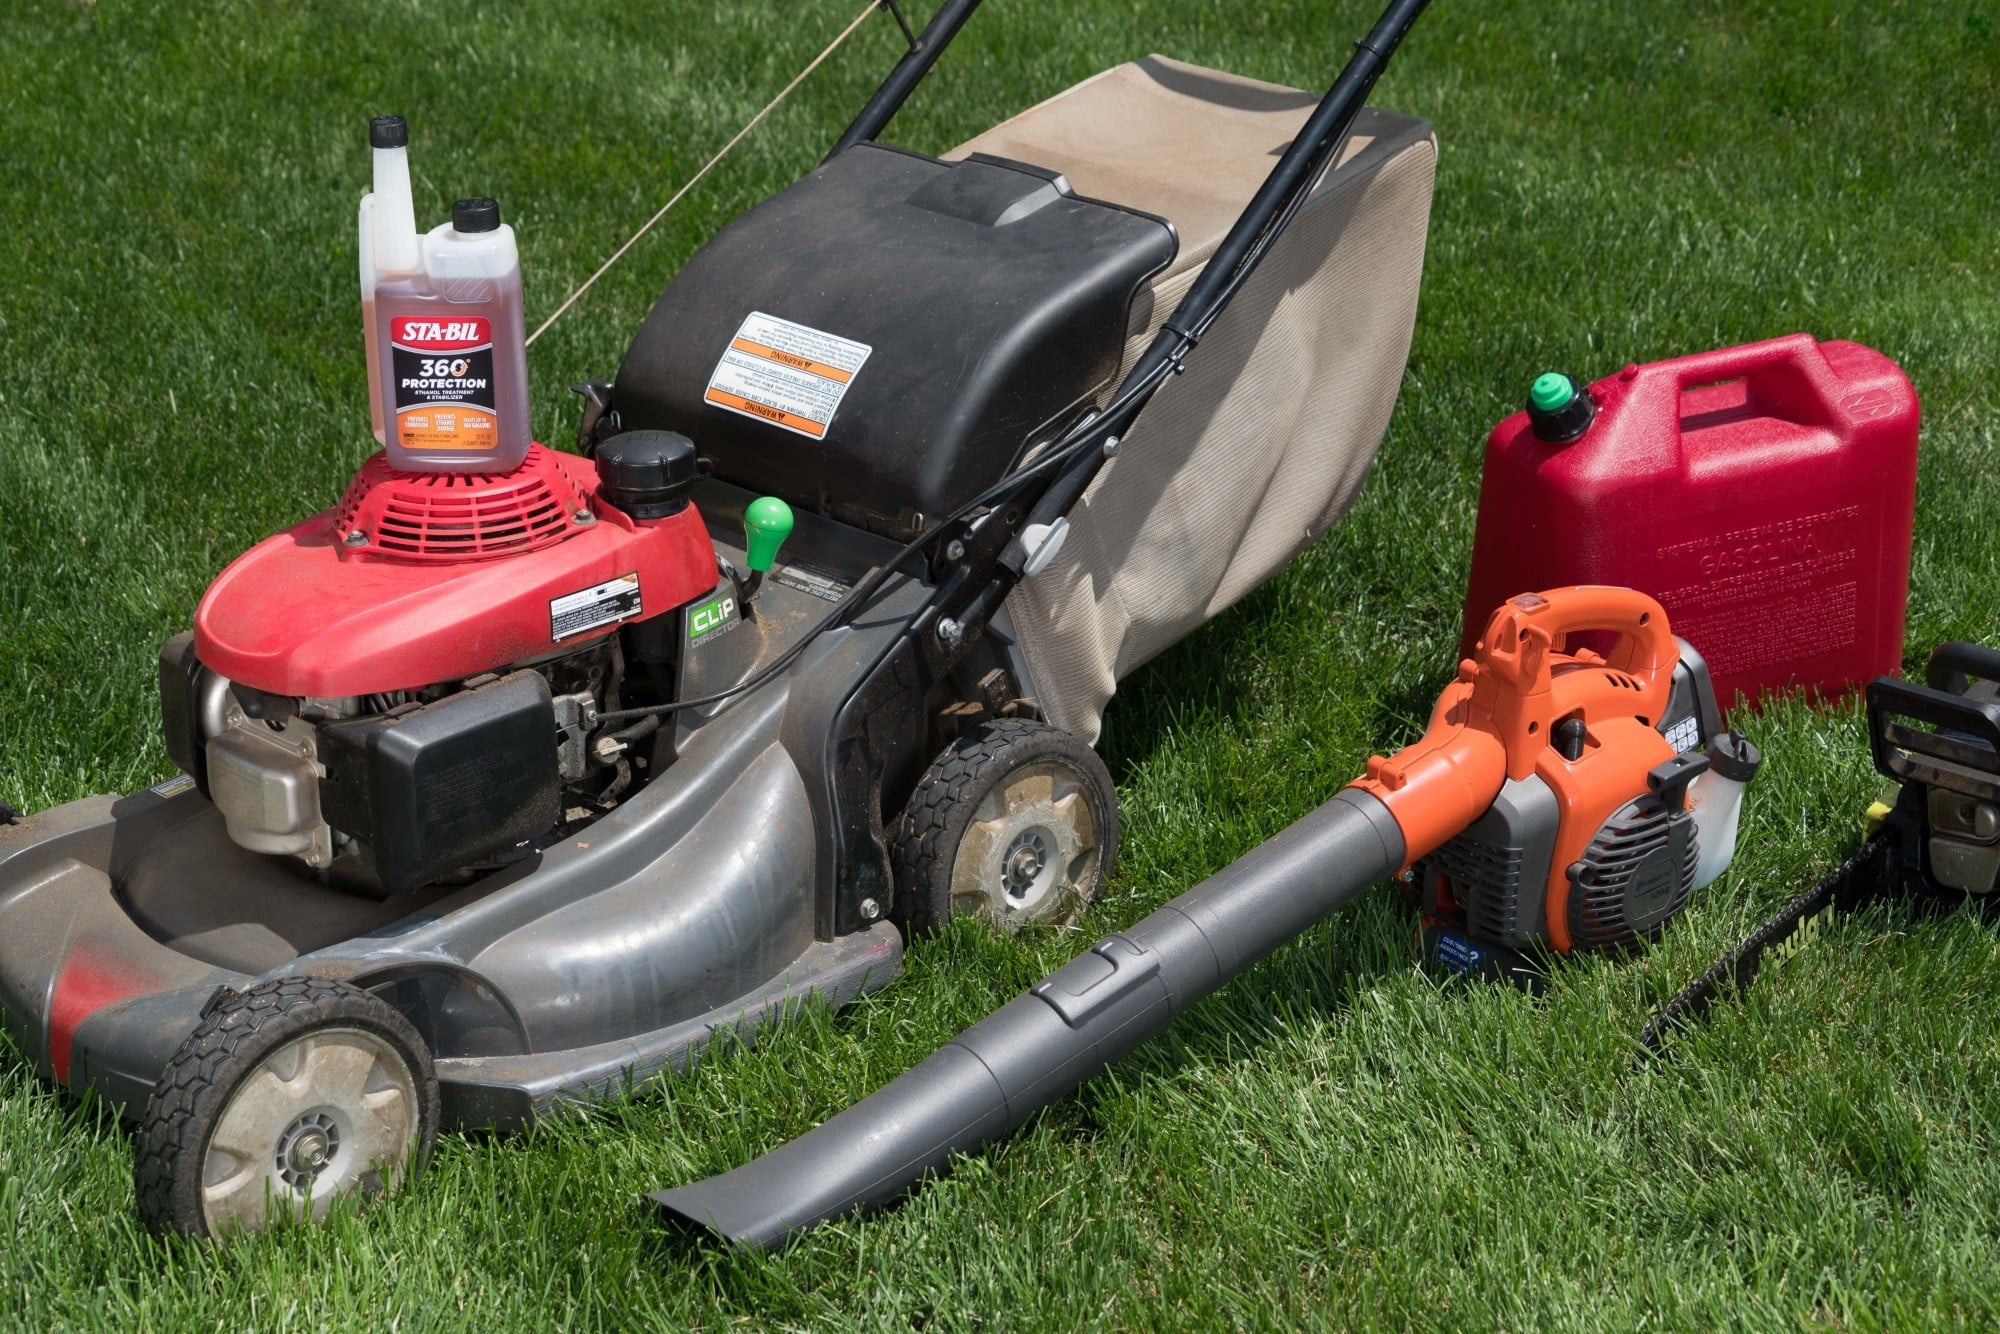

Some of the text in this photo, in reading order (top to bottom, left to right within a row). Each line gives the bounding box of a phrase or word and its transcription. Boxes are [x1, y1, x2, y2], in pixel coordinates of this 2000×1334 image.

[402, 322, 480, 341] STA-BIL
[769, 350, 804, 366] WARNING
[402, 378, 487, 389] PROTECTION
[742, 401, 778, 419] WARNING
[1698, 532, 1818, 575] GASOLINA
[691, 618, 741, 649] DIRECTOR
